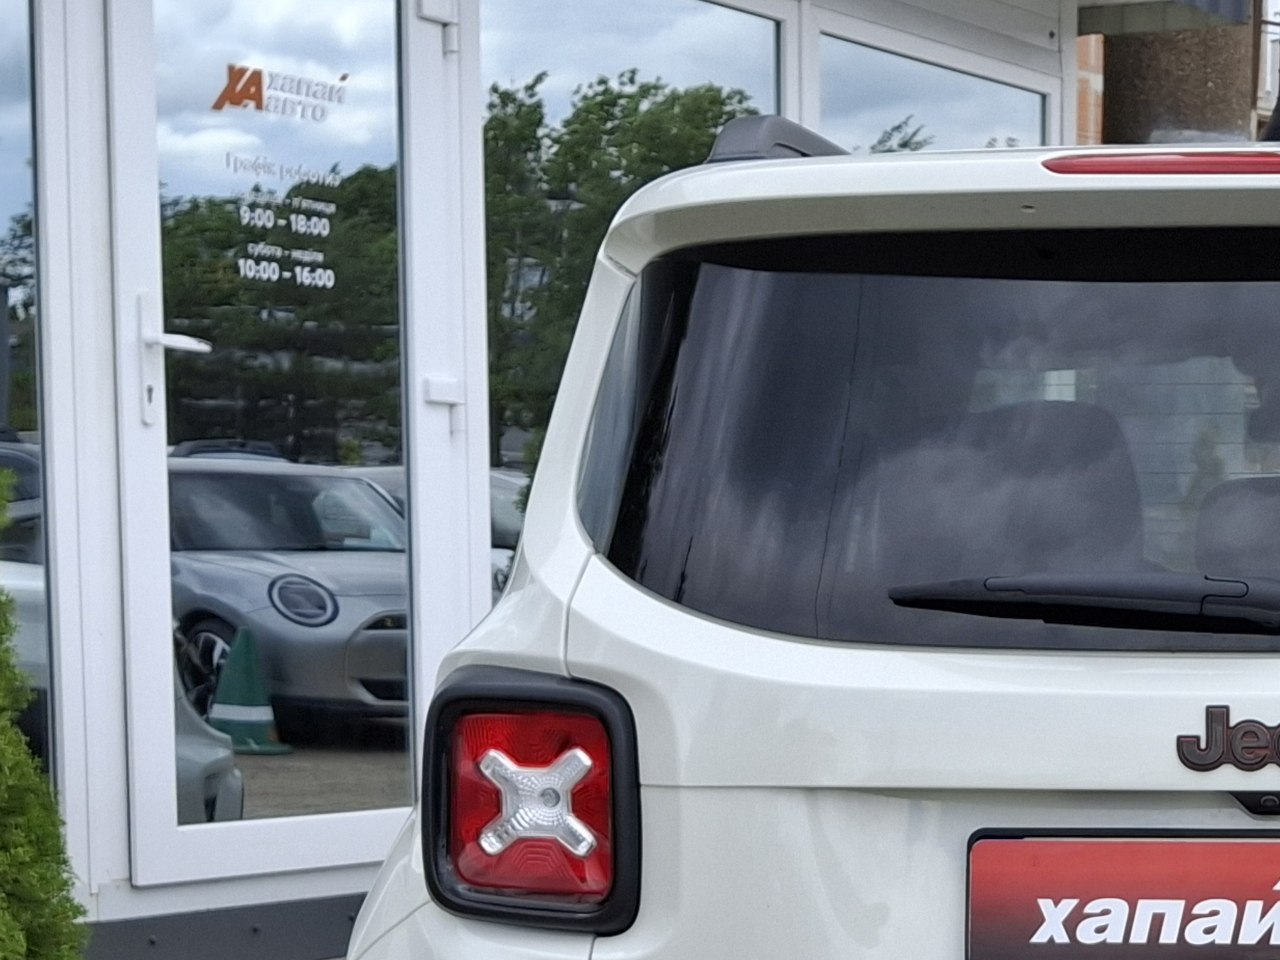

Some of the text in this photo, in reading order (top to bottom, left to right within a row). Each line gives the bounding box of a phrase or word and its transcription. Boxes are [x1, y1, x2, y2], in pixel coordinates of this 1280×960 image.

[264, 94, 328, 121] авто
[240, 205, 275, 229] 9:00
[289, 213, 330, 238] 18:00
[238, 258, 280, 282] 10:00
[294, 266, 335, 289] 16:00
